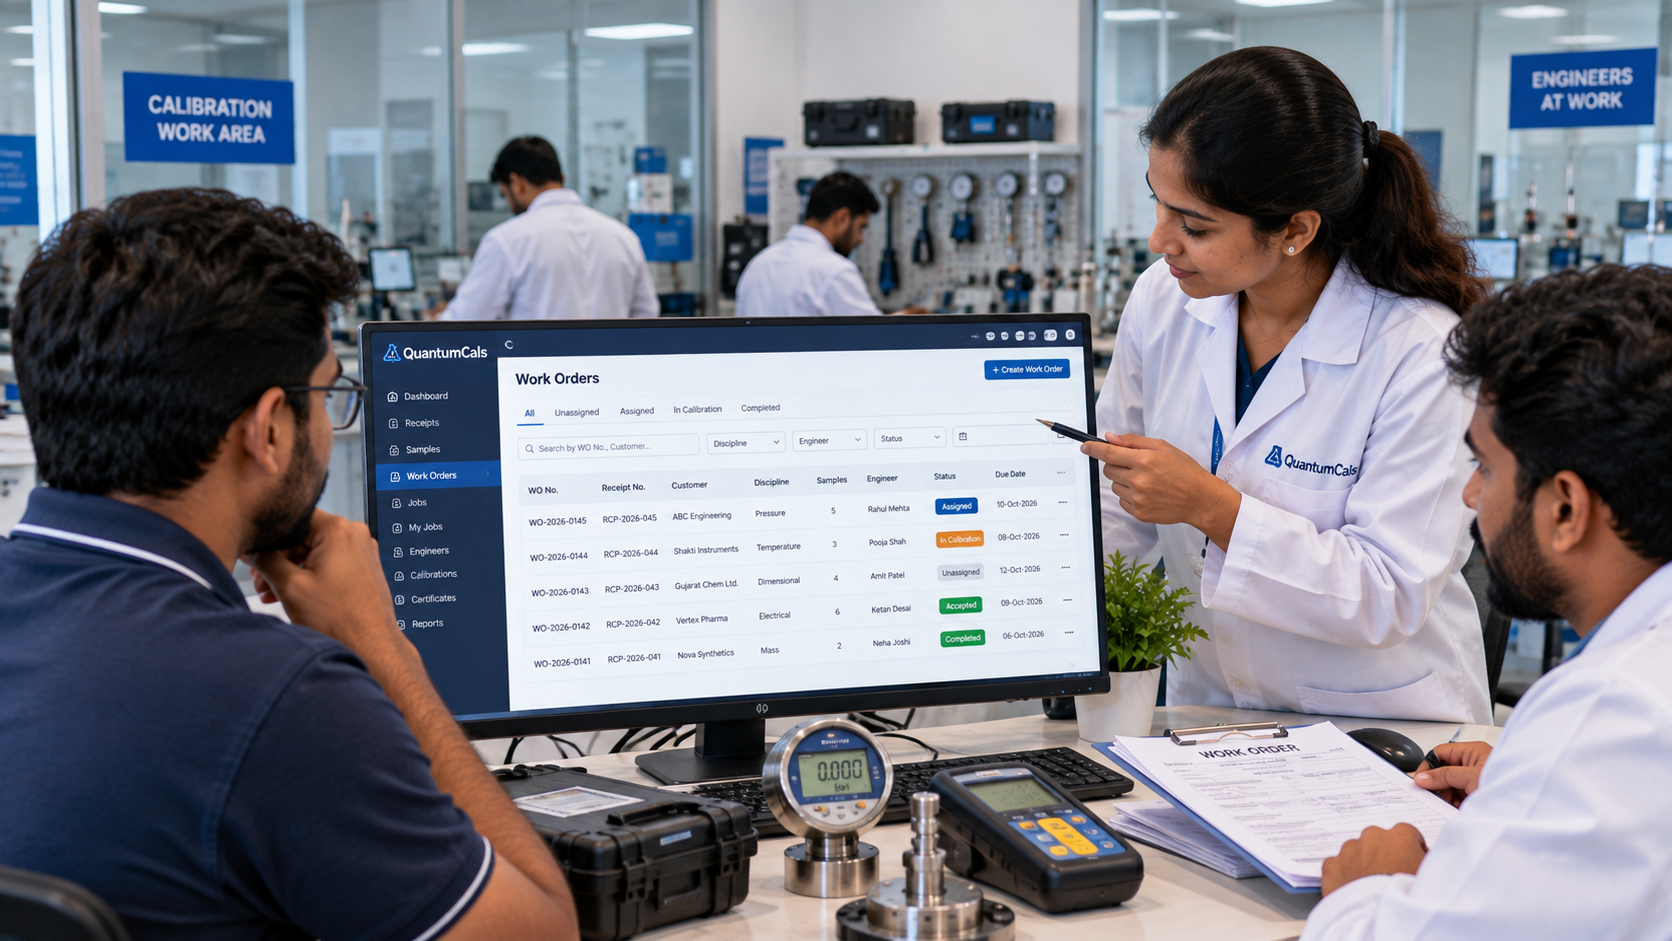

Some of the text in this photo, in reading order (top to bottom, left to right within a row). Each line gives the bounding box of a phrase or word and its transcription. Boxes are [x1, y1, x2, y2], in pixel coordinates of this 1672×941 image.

[1532, 66, 1633, 89] ENGINEERS
[1540, 91, 1623, 111] AT WORK
[148, 94, 272, 119] CALIBRATION
[157, 122, 266, 144] WORK AREA
[403, 346, 487, 360] QuantumCals
[516, 372, 599, 385] Work Orders
[405, 392, 448, 400] Dashboard
[555, 408, 599, 418] Unassigned
[620, 407, 654, 416] Assigned
[741, 404, 780, 413] Completed
[406, 419, 439, 428] Receipts
[714, 440, 747, 448] Discipline
[799, 436, 829, 446] Engineer
[406, 445, 440, 455] Samples
[567, 444, 576, 453] by
[1285, 454, 1358, 477] QuantumCals
[407, 472, 428, 480] Work
[817, 476, 847, 485] Samples
[867, 475, 898, 484] Engineer
[754, 478, 789, 487] Discipline
[602, 484, 631, 492] Receipt
[868, 504, 887, 512] Rahul
[997, 500, 1037, 508] 10-Oct-2026
[603, 514, 657, 523] RCP-2026-045
[690, 512, 732, 521] Engineering
[529, 517, 587, 526] WO-2026-0145
[409, 523, 443, 533] My Jobs
[757, 542, 801, 552] Temperature
[869, 539, 888, 547] Pooja
[410, 547, 449, 557] Engineers
[604, 549, 658, 558] RCP-2026-044
[674, 546, 739, 555] Shakti Instruments
[530, 552, 588, 561] WO-2026-0144
[942, 569, 980, 577] Unassigned
[1000, 565, 1040, 573] 12-Oct-2026
[675, 579, 739, 591] Gujarat Chem Ltd.
[758, 577, 800, 585] Dimensional
[531, 587, 589, 597] WO-2026-0143
[605, 584, 659, 593] RCP-2026-043
[1001, 598, 1043, 606] 09-Oct-2026
[701, 614, 728, 622] Pharma
[759, 611, 791, 620] Electrical
[412, 618, 443, 629] Reports
[532, 622, 590, 632] WO-2026-0142
[607, 618, 660, 628] RCP-2026-042
[1003, 631, 1044, 639] 06-Oct-2026
[893, 638, 910, 646] Joshi
[608, 653, 660, 663] RCP-2026-041
[698, 649, 734, 659] Synthetics
[534, 658, 590, 668] WO-2026-0141
[1199, 744, 1300, 758] WORK ORDER
[818, 759, 862, 781] 0.000
